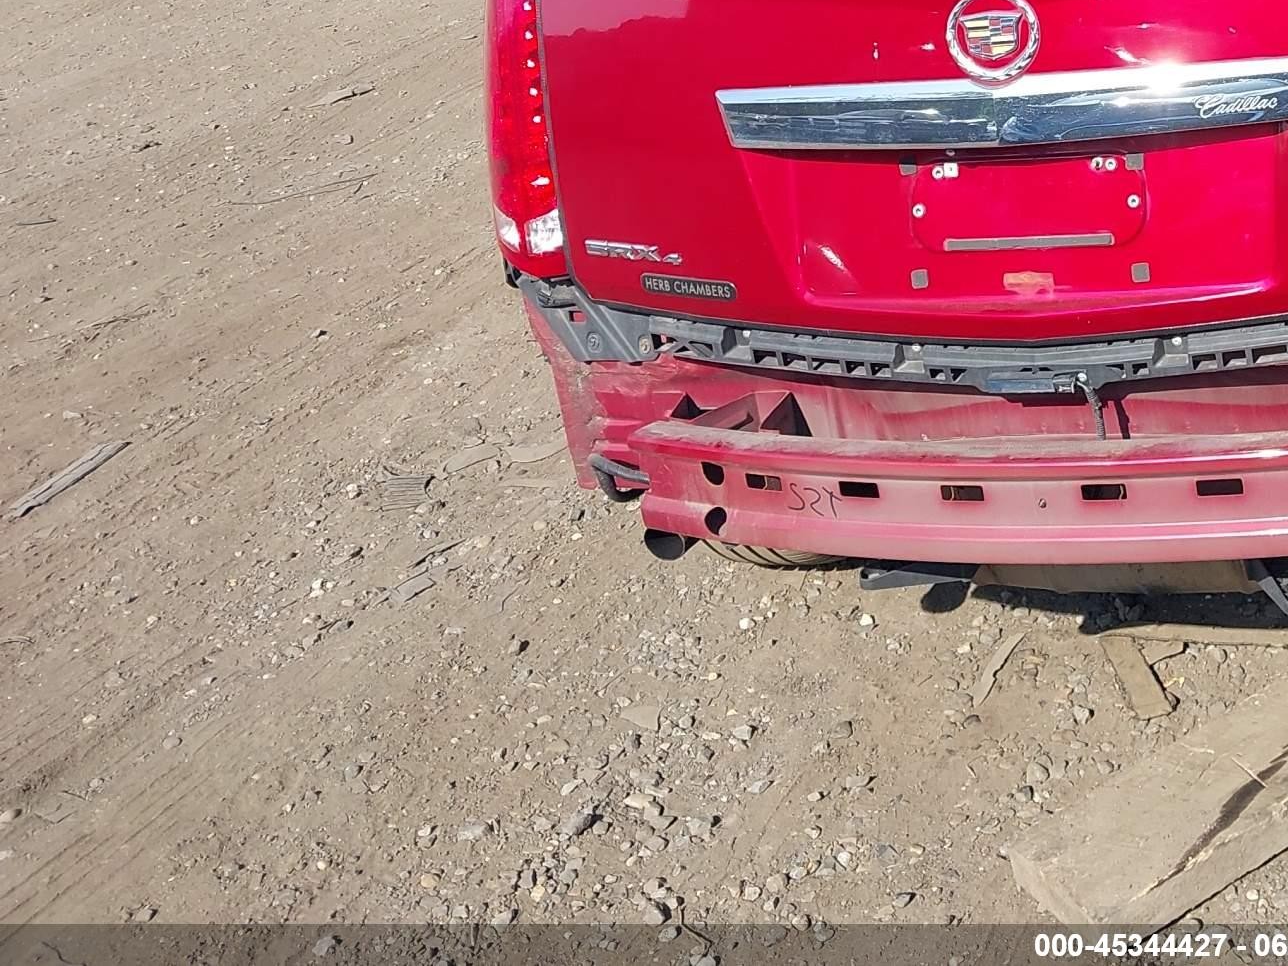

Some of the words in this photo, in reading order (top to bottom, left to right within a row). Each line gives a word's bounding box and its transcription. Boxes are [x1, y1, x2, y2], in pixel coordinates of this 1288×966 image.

[1194, 95, 1278, 119] Cadillac
[645, 277, 671, 292] HERB
[673, 281, 731, 299] CHAMBERS
